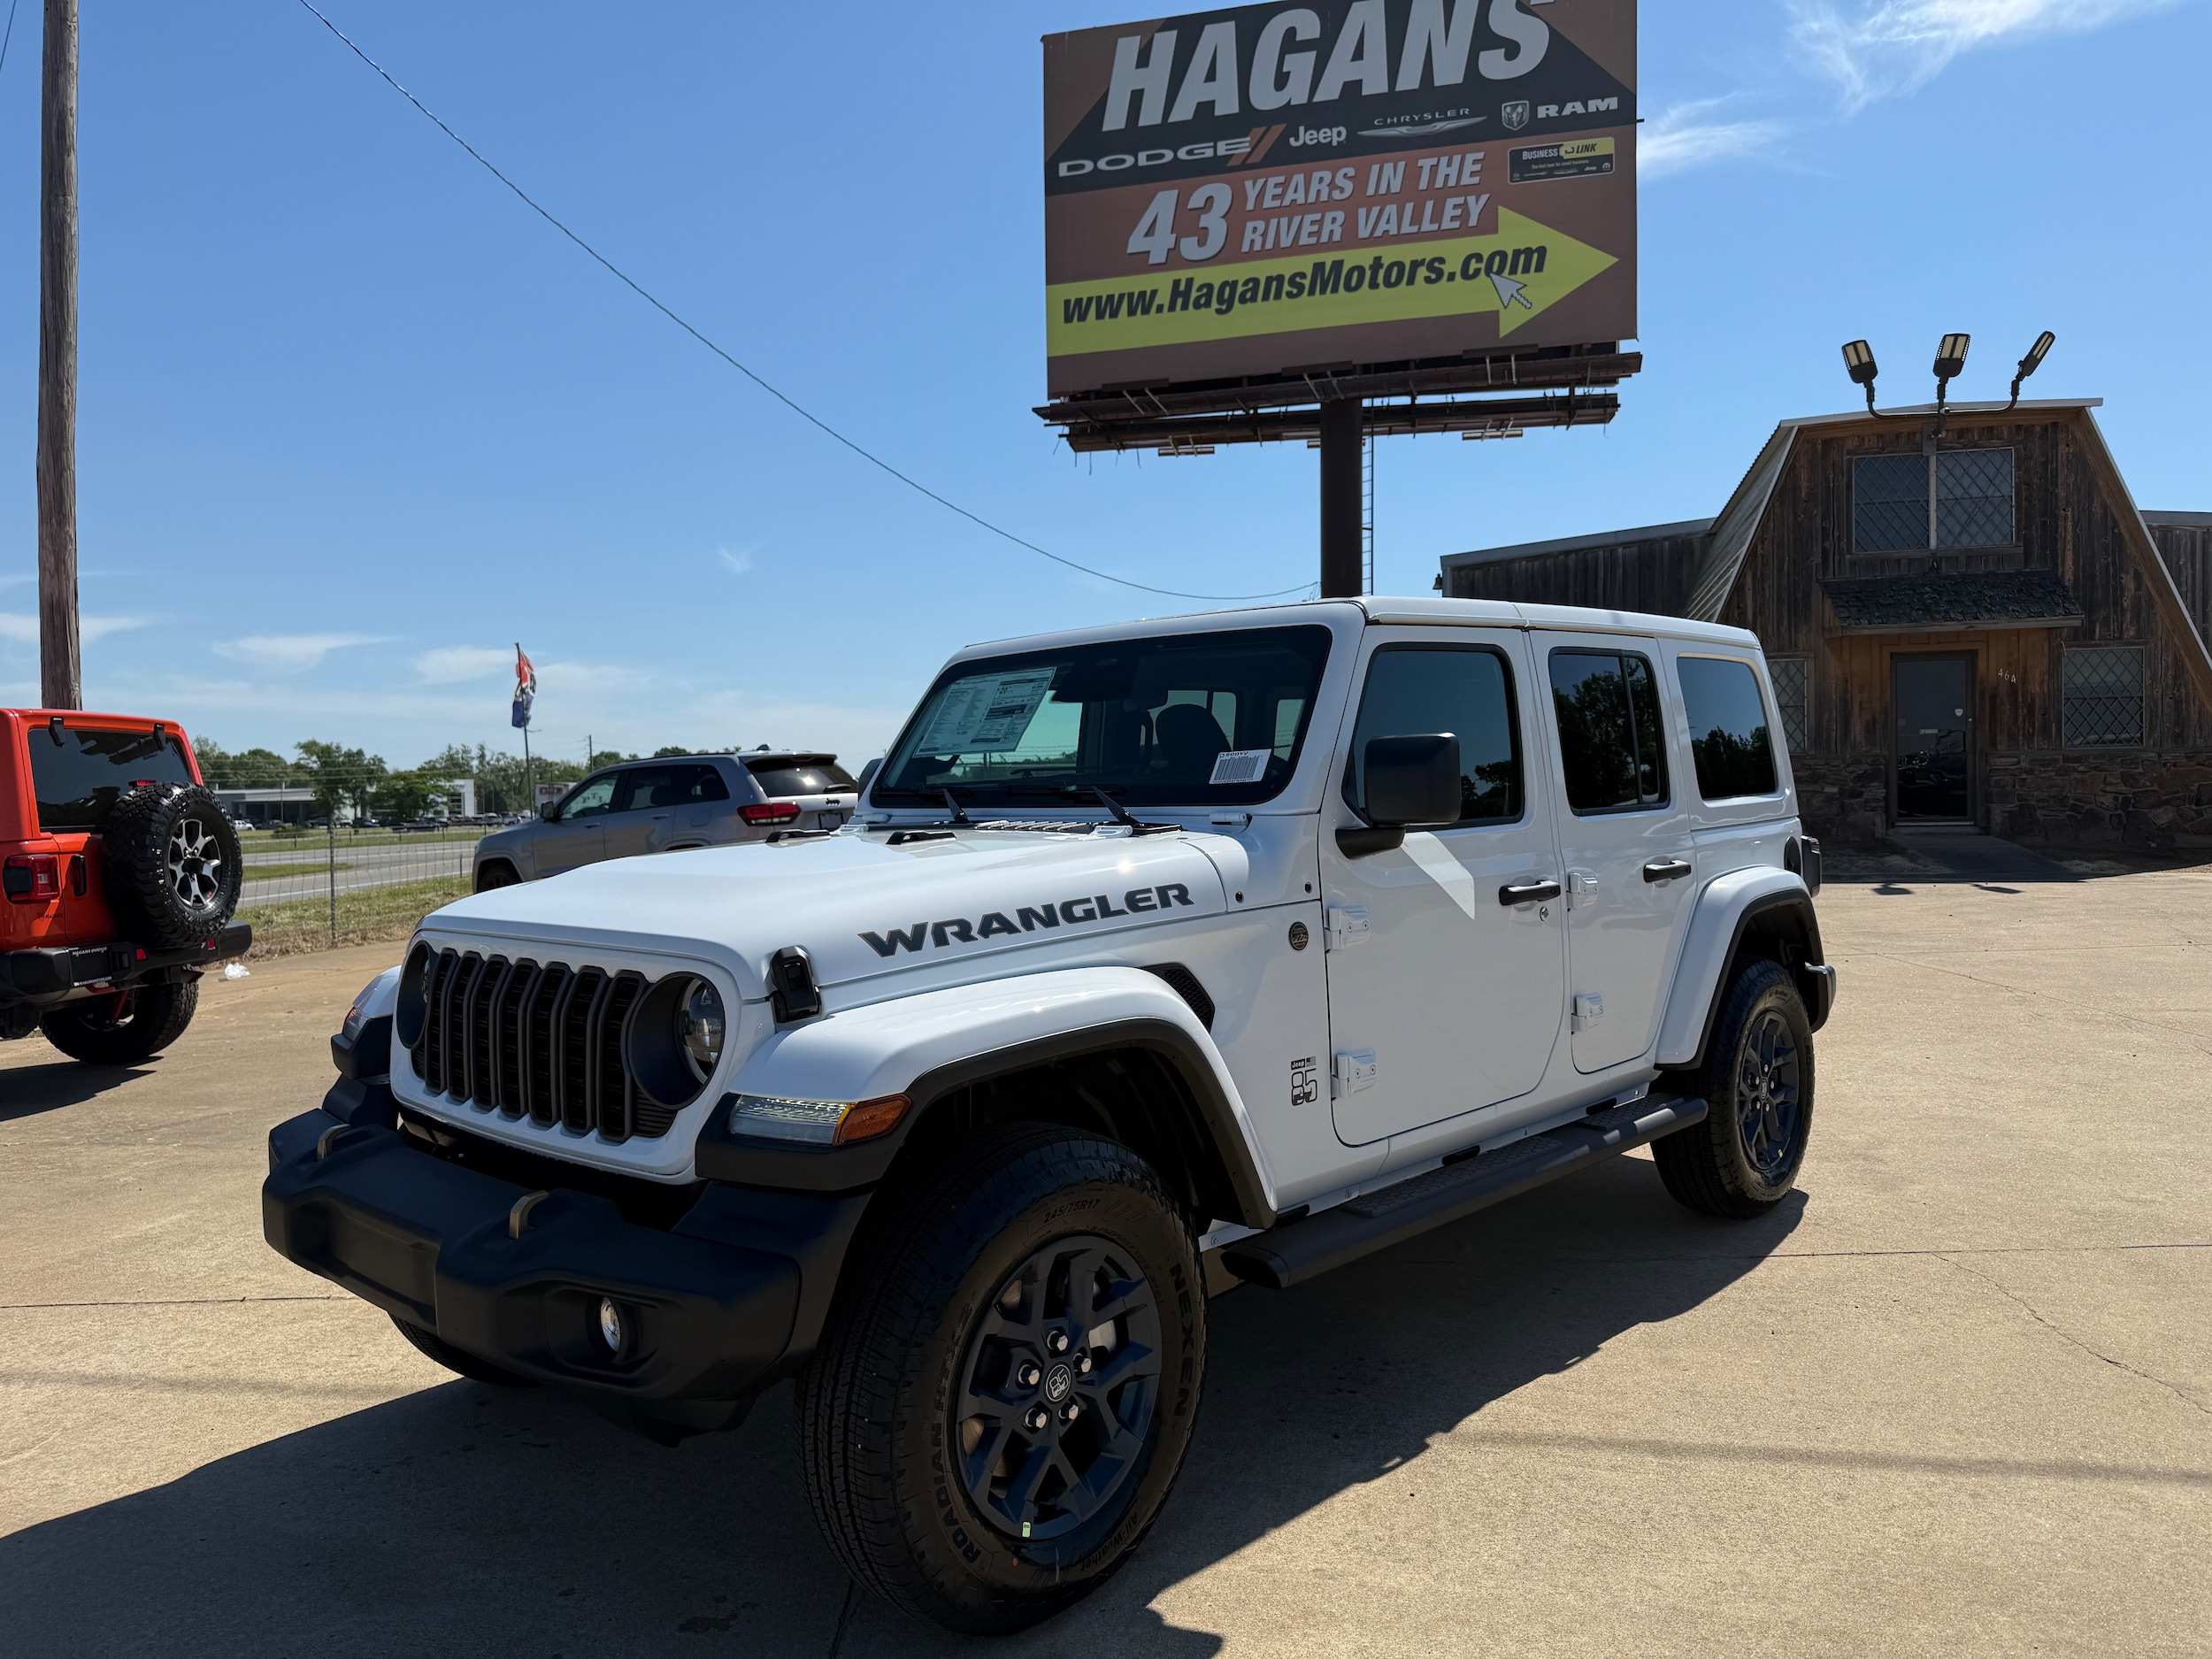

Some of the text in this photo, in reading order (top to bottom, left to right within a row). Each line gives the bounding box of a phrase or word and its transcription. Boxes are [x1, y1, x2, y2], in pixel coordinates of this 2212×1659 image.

[1102, 0, 1555, 131] HAGANS
[1058, 96, 1618, 177] DODGE Jeep CHRYSLER RAM
[1522, 143, 1597, 160] BUSINESS LINK
[1242, 150, 1485, 211] YEARS IN THE
[1126, 182, 1233, 265] 43
[1241, 194, 1490, 253] RIVER VALLEY
[1063, 245, 1548, 324] www.HagansMotors.com
[1997, 667, 2017, 684] 464
[856, 882, 1195, 958] WRANGLER
[1291, 1067, 1317, 1107] 85
[1042, 1198, 1102, 1225] 245/75R17
[1169, 1262, 1194, 1419] NEXEN
[930, 1422, 982, 1565] ROADIAN
[1079, 1513, 1139, 1572] All-Weather
